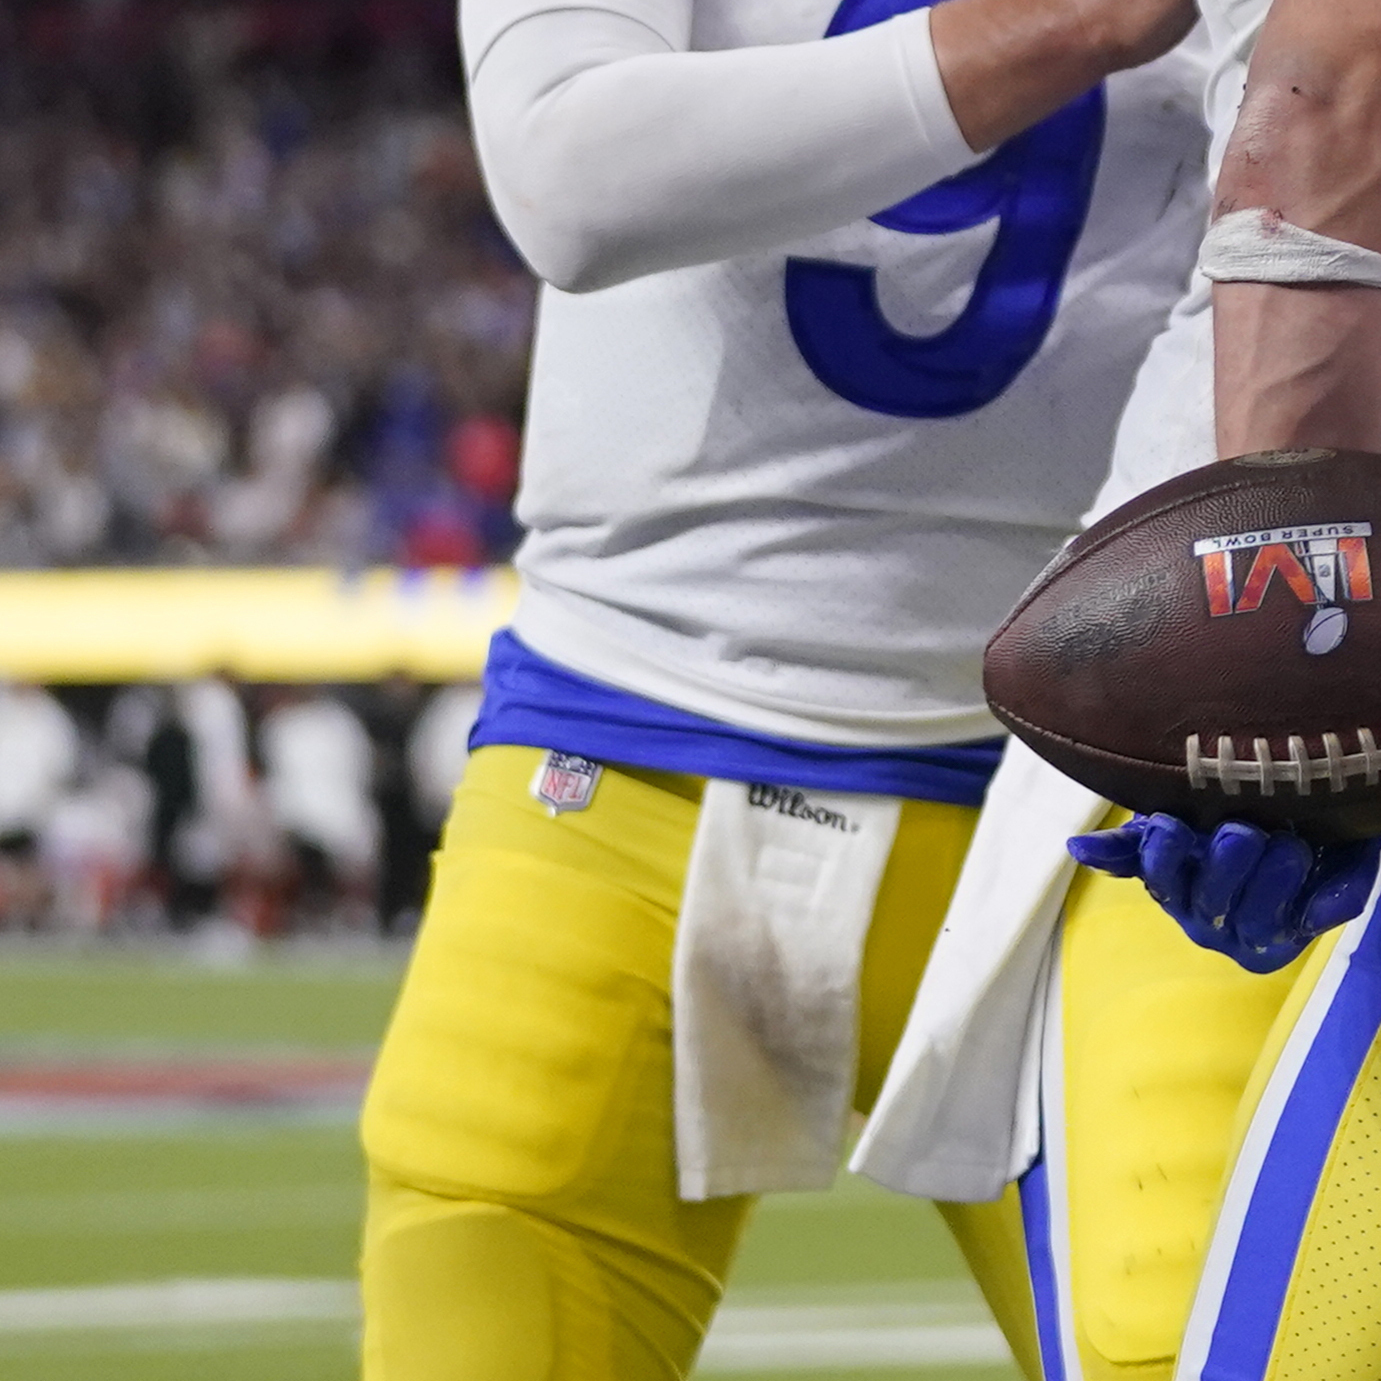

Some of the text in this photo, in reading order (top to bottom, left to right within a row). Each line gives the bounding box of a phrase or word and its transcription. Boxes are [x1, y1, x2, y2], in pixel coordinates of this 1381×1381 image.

[1212, 524, 1356, 548] SUPER BOWL
[1202, 536, 1374, 617] LVI
[543, 768, 583, 800] NFL
[748, 782, 847, 832] Wilson
